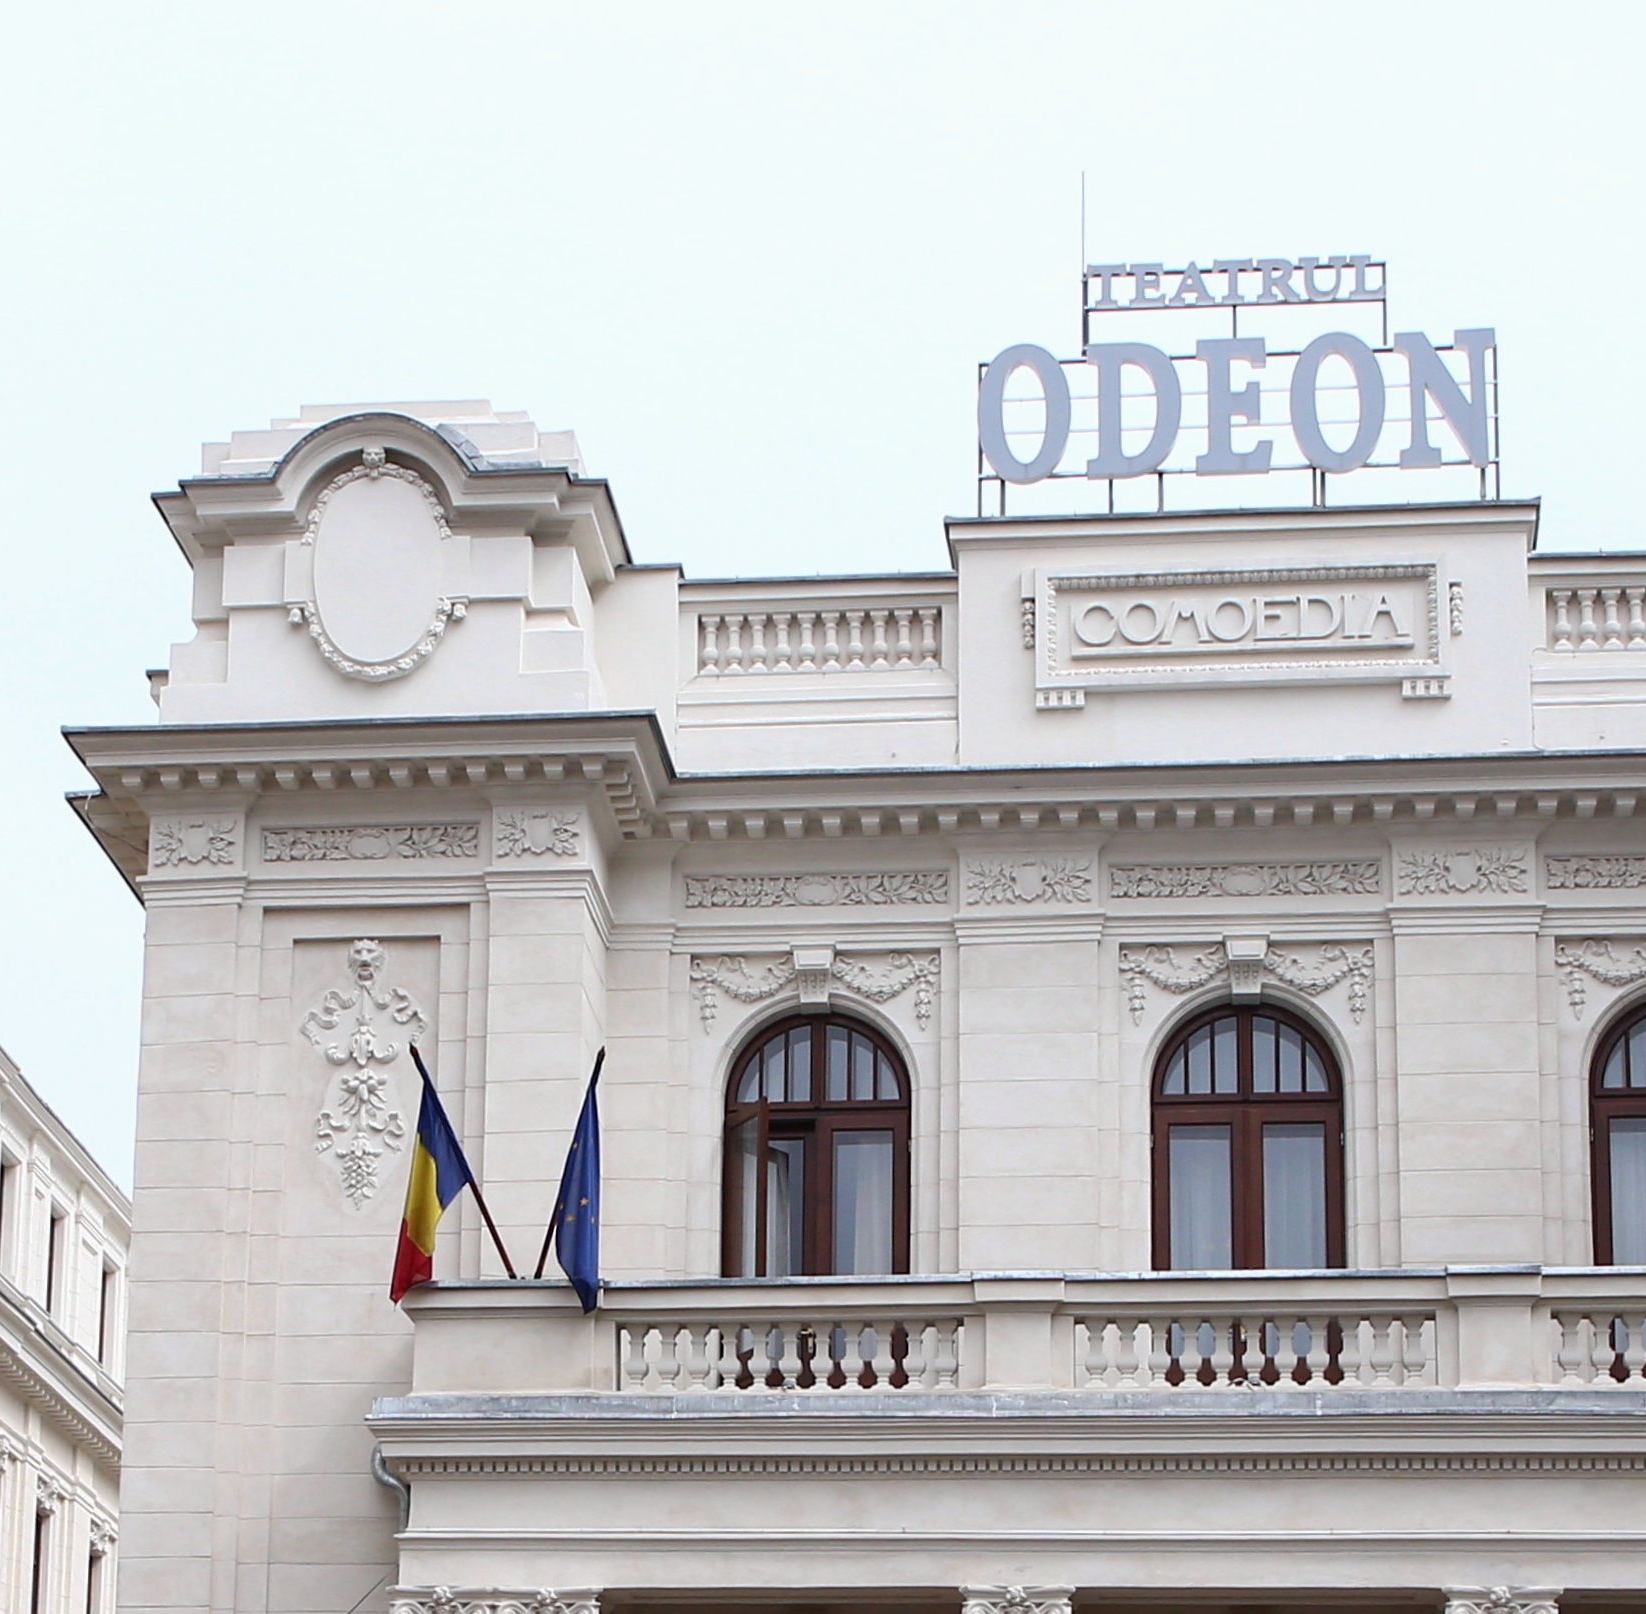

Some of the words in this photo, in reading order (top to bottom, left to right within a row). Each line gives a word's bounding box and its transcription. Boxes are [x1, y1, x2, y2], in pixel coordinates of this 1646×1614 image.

[1086, 255, 1386, 307] TEATRUL
[978, 327, 1496, 485] ODEON
[1072, 594, 1410, 646] COMOEDIA
